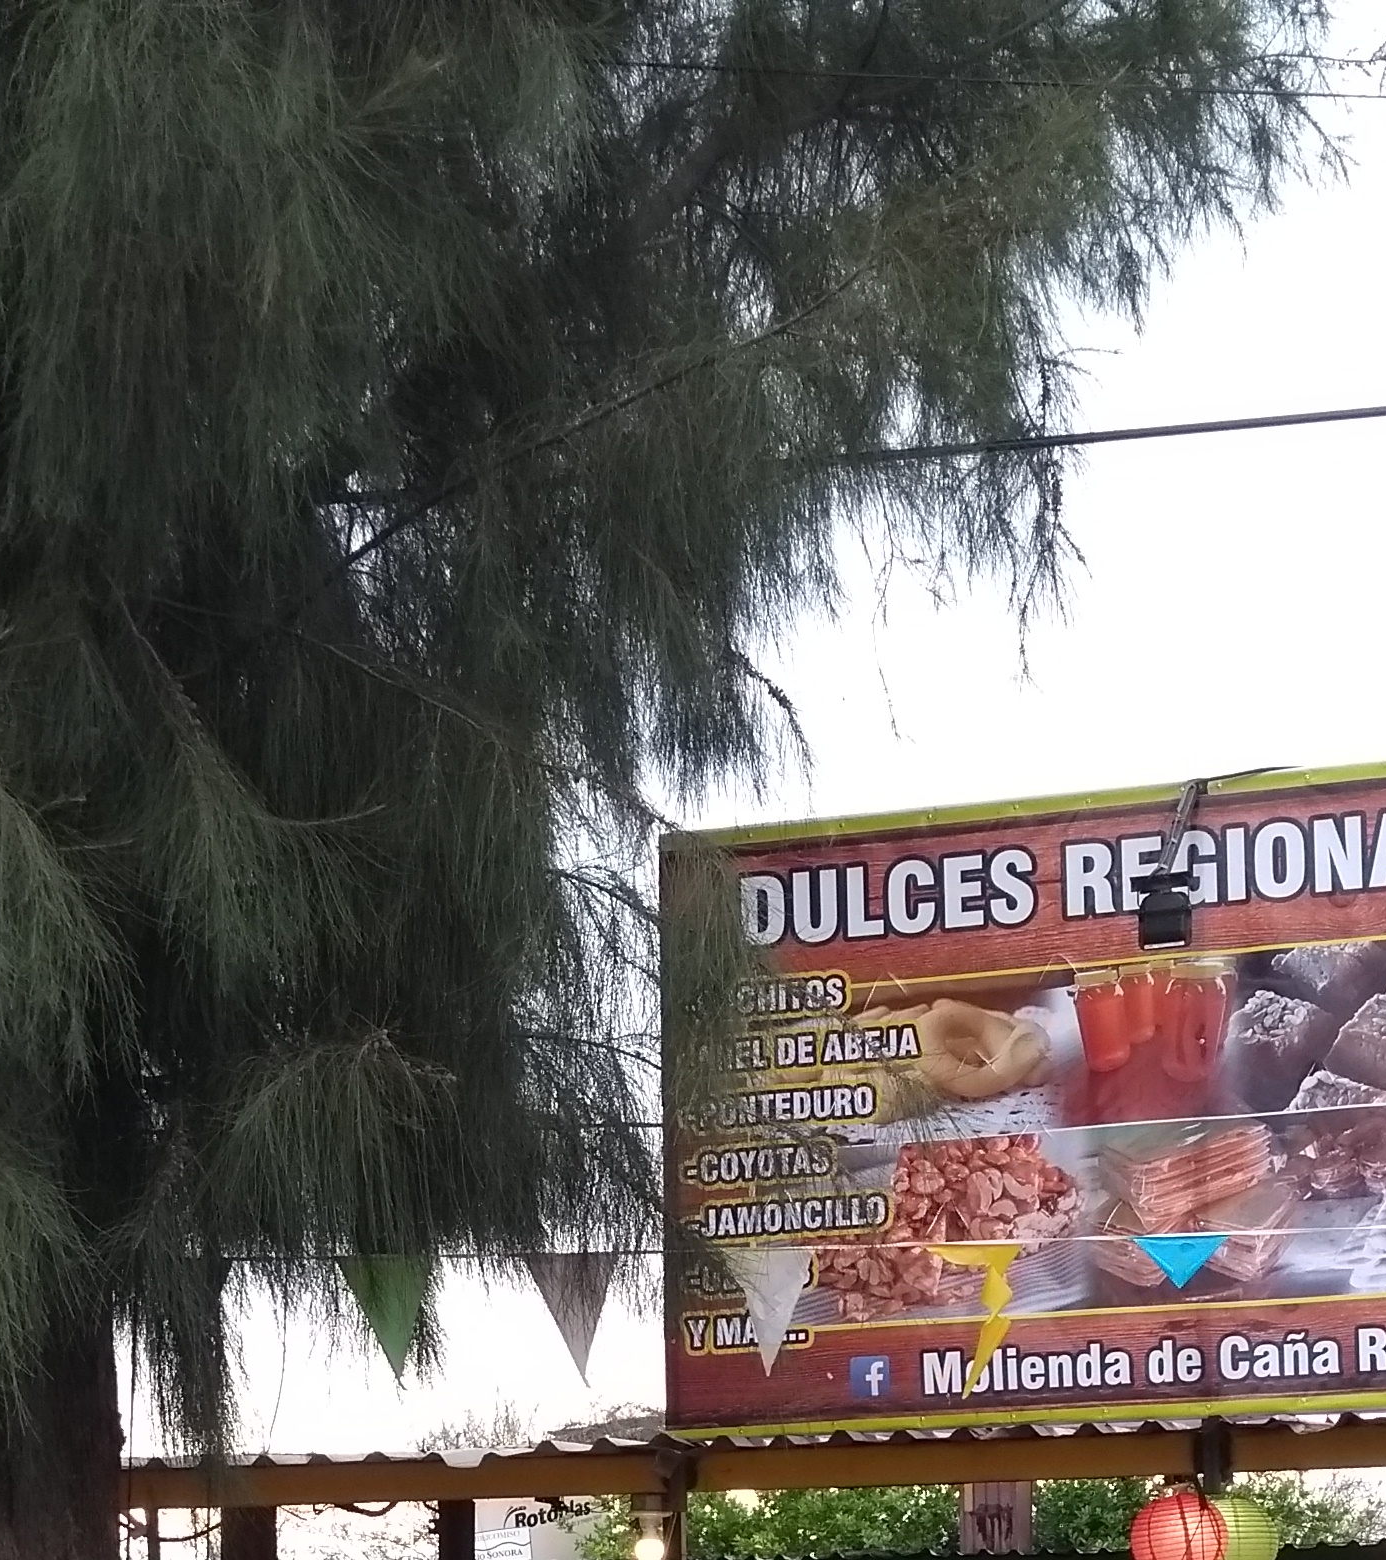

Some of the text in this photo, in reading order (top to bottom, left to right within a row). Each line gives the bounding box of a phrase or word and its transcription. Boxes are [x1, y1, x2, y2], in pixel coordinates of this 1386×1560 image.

[739, 849, 1035, 945] DULCES
[777, 1034, 815, 1067] DE
[823, 1028, 919, 1065] ABEJA
[687, 1144, 830, 1183] -COYOTAS
[687, 1319, 707, 1348] Y
[922, 1342, 1132, 1396] Molienda
[1148, 1339, 1202, 1384] de
[1219, 1332, 1340, 1380] Caña
[486, 1548, 523, 1560] SONORA
